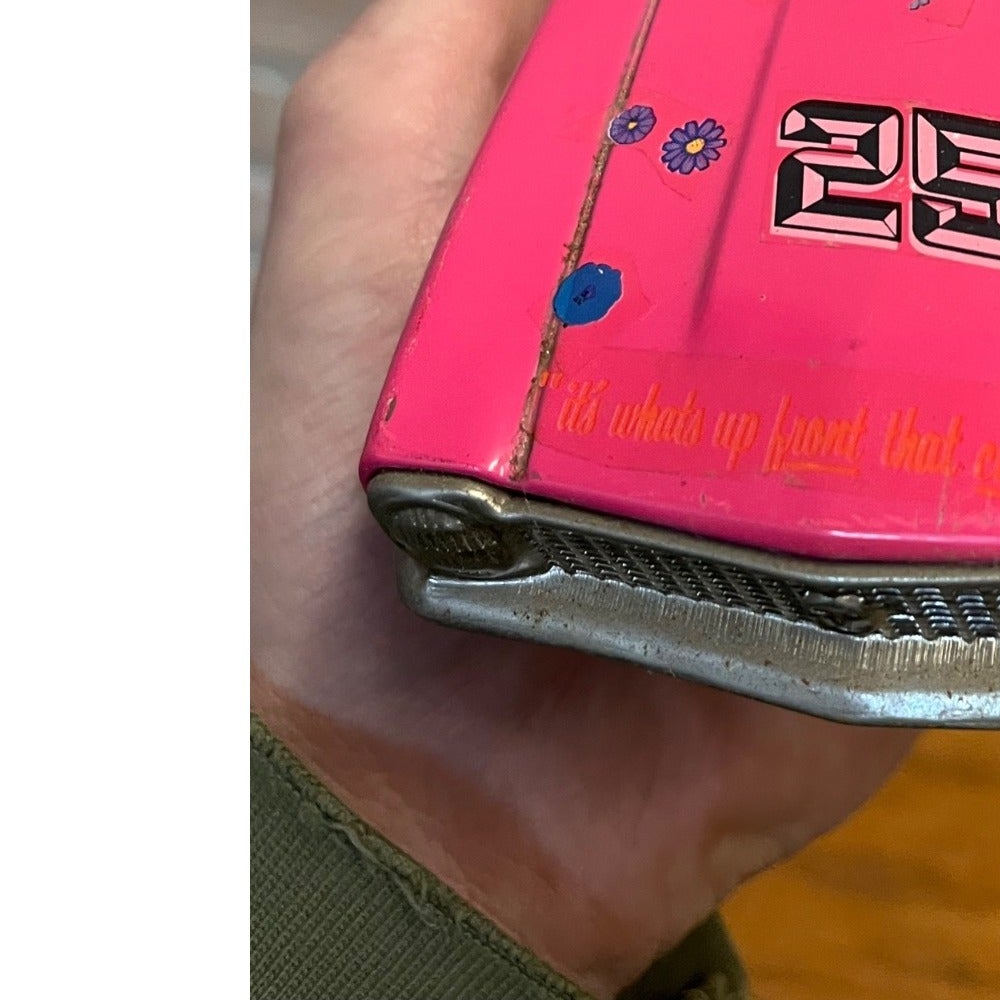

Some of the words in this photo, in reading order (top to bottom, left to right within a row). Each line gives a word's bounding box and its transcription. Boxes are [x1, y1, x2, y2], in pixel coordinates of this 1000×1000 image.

[712, 411, 761, 471] up
[761, 393, 869, 477] front
[881, 406, 964, 476] that
